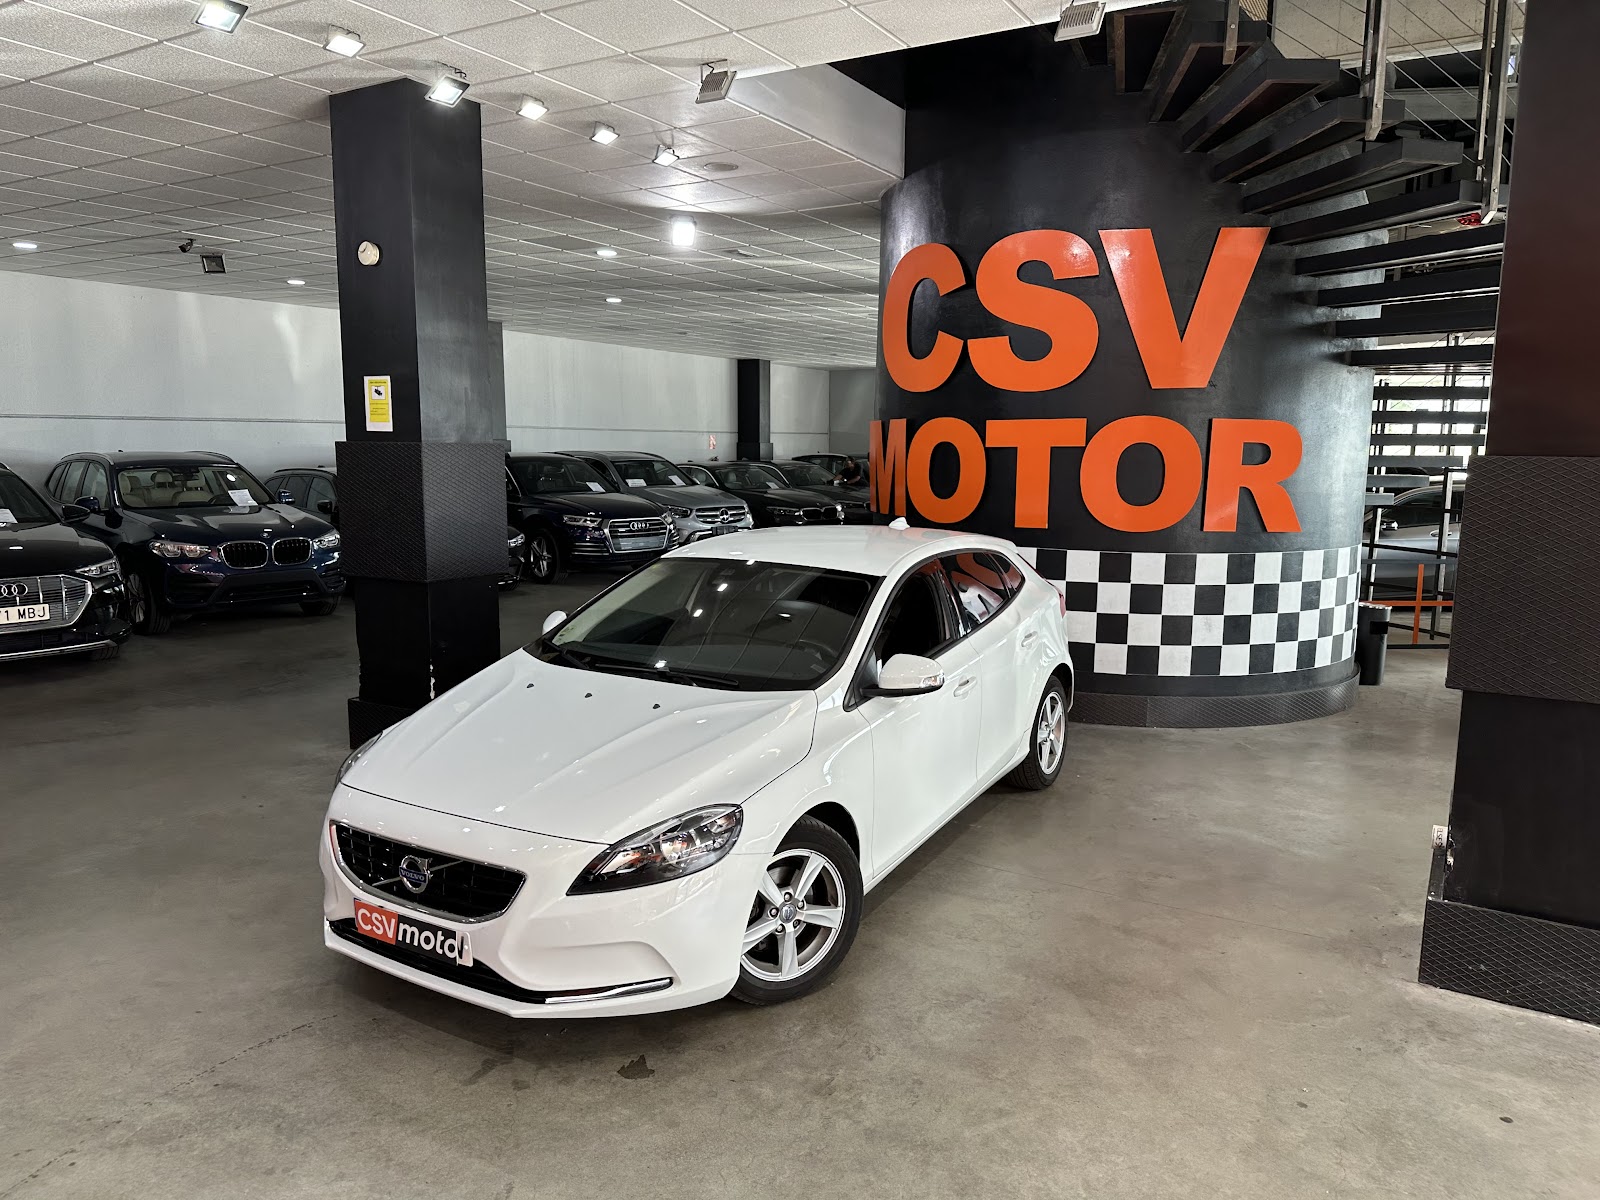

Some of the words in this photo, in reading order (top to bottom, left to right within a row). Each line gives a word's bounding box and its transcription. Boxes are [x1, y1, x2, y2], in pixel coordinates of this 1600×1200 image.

[882, 227, 1271, 393] CSV
[869, 415, 1303, 533] MOTOR
[18, 606, 46, 620] MBJ
[400, 868, 425, 881] VOLVO
